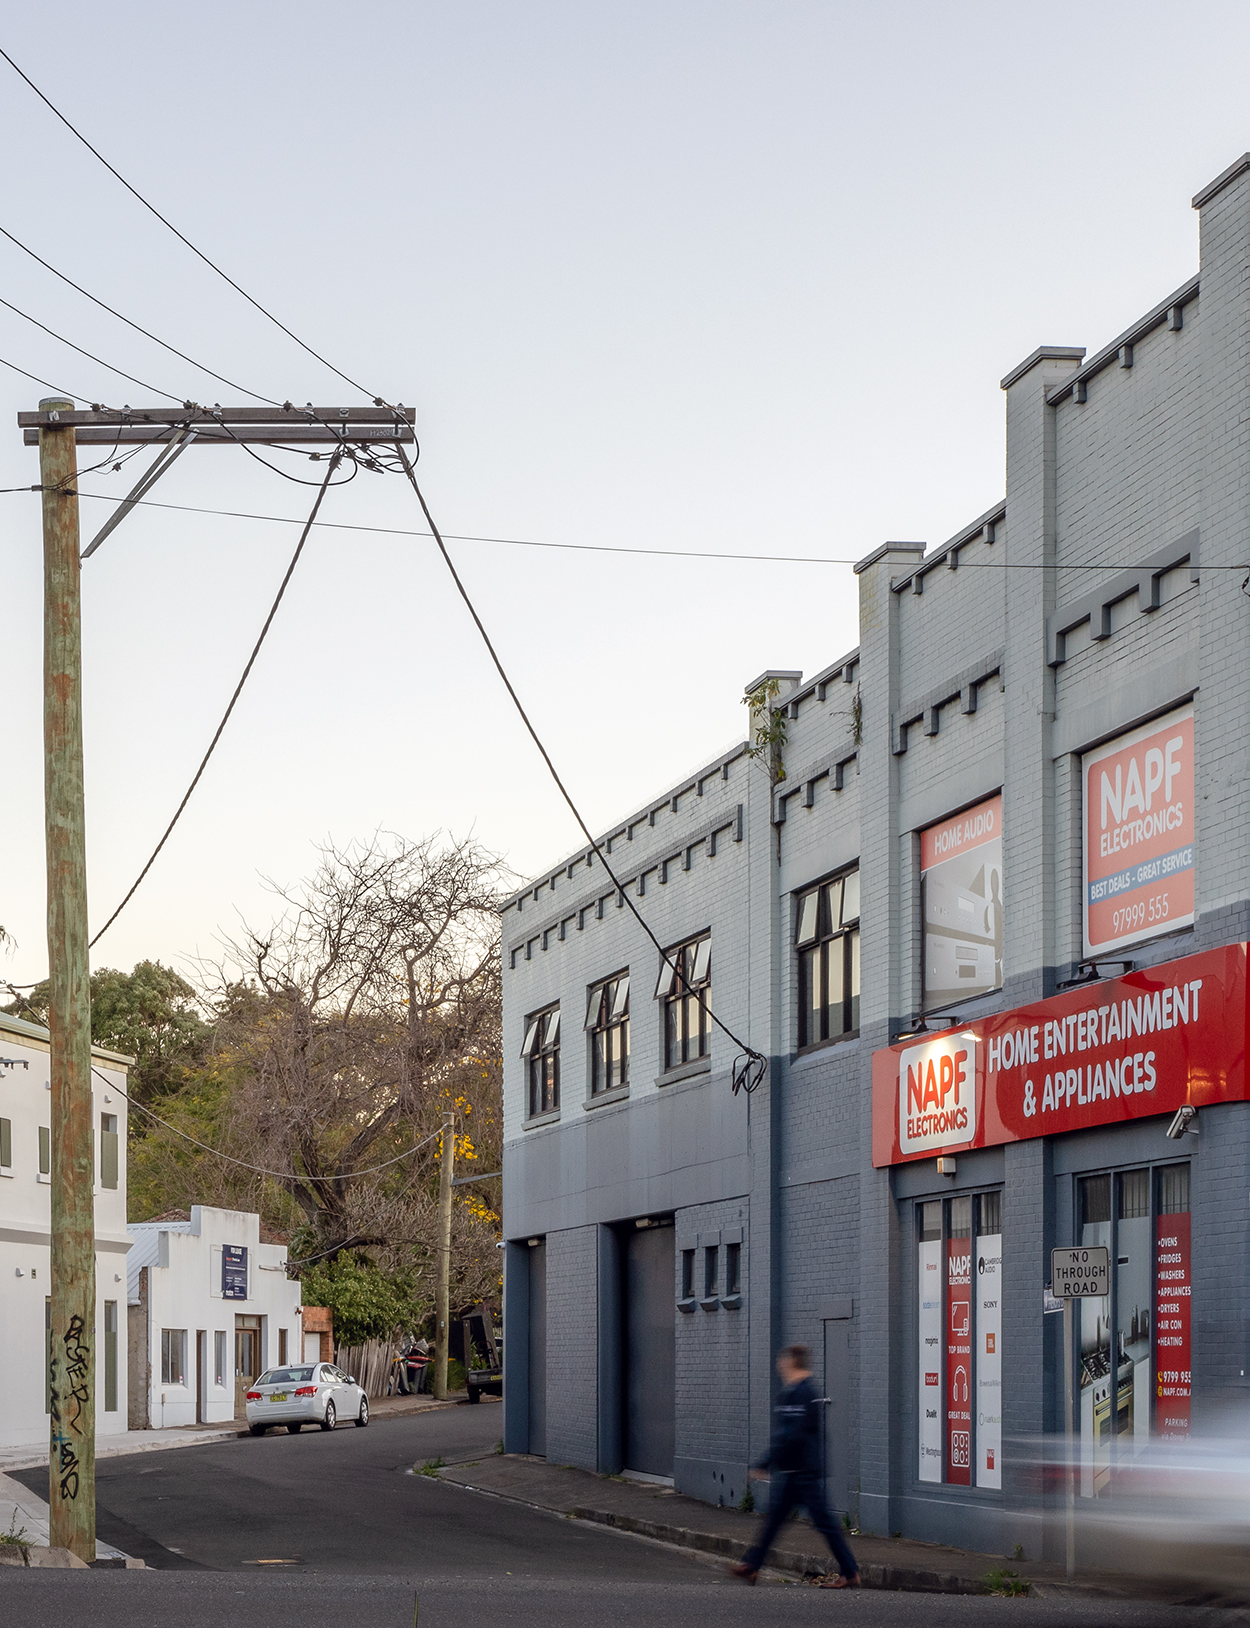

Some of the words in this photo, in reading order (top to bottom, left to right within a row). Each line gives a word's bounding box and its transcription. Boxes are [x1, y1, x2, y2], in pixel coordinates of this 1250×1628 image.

[1100, 735, 1184, 830] NAPF
[934, 824, 962, 856] HOME
[963, 809, 994, 843] AUDIO
[1100, 802, 1184, 857] ELECTRONICS
[1091, 881, 1108, 900] BEST
[1108, 872, 1130, 894] DEALS
[1137, 860, 1161, 883] GREAT
[1162, 848, 1192, 874] SERVICE
[1113, 902, 1145, 933] 97999
[1148, 893, 1169, 921] 555
[989, 1025, 1039, 1073] HOME
[1044, 979, 1203, 1060] ENTERTAINMENT
[907, 1049, 968, 1116] NAPF
[1023, 1079, 1037, 1118] &
[1041, 1050, 1157, 1113] APPLIANCES
[907, 1106, 968, 1139] ELECTRONICS
[1160, 1237, 1178, 1247] OVENS
[1072, 1251, 1089, 1263] NO
[1160, 1253, 1182, 1264] FRIDGES
[949, 1255, 970, 1276] NAPF
[1056, 1265, 1106, 1279] THROUGH
[1160, 1270, 1185, 1280] WASHERS
[1064, 1281, 1098, 1294] ROAD
[1160, 1286, 1191, 1296] APPLIANCES
[1160, 1303, 1180, 1313] DRYERS
[1160, 1321, 1169, 1330] AIR
[1170, 1320, 1182, 1330] CON
[1160, 1337, 1183, 1346] HEATING
[948, 1346, 956, 1354] TOP
[1163, 1371, 1179, 1383] 9799
[948, 1411, 960, 1420] GREAT
[1164, 1418, 1188, 1427] PARKING
